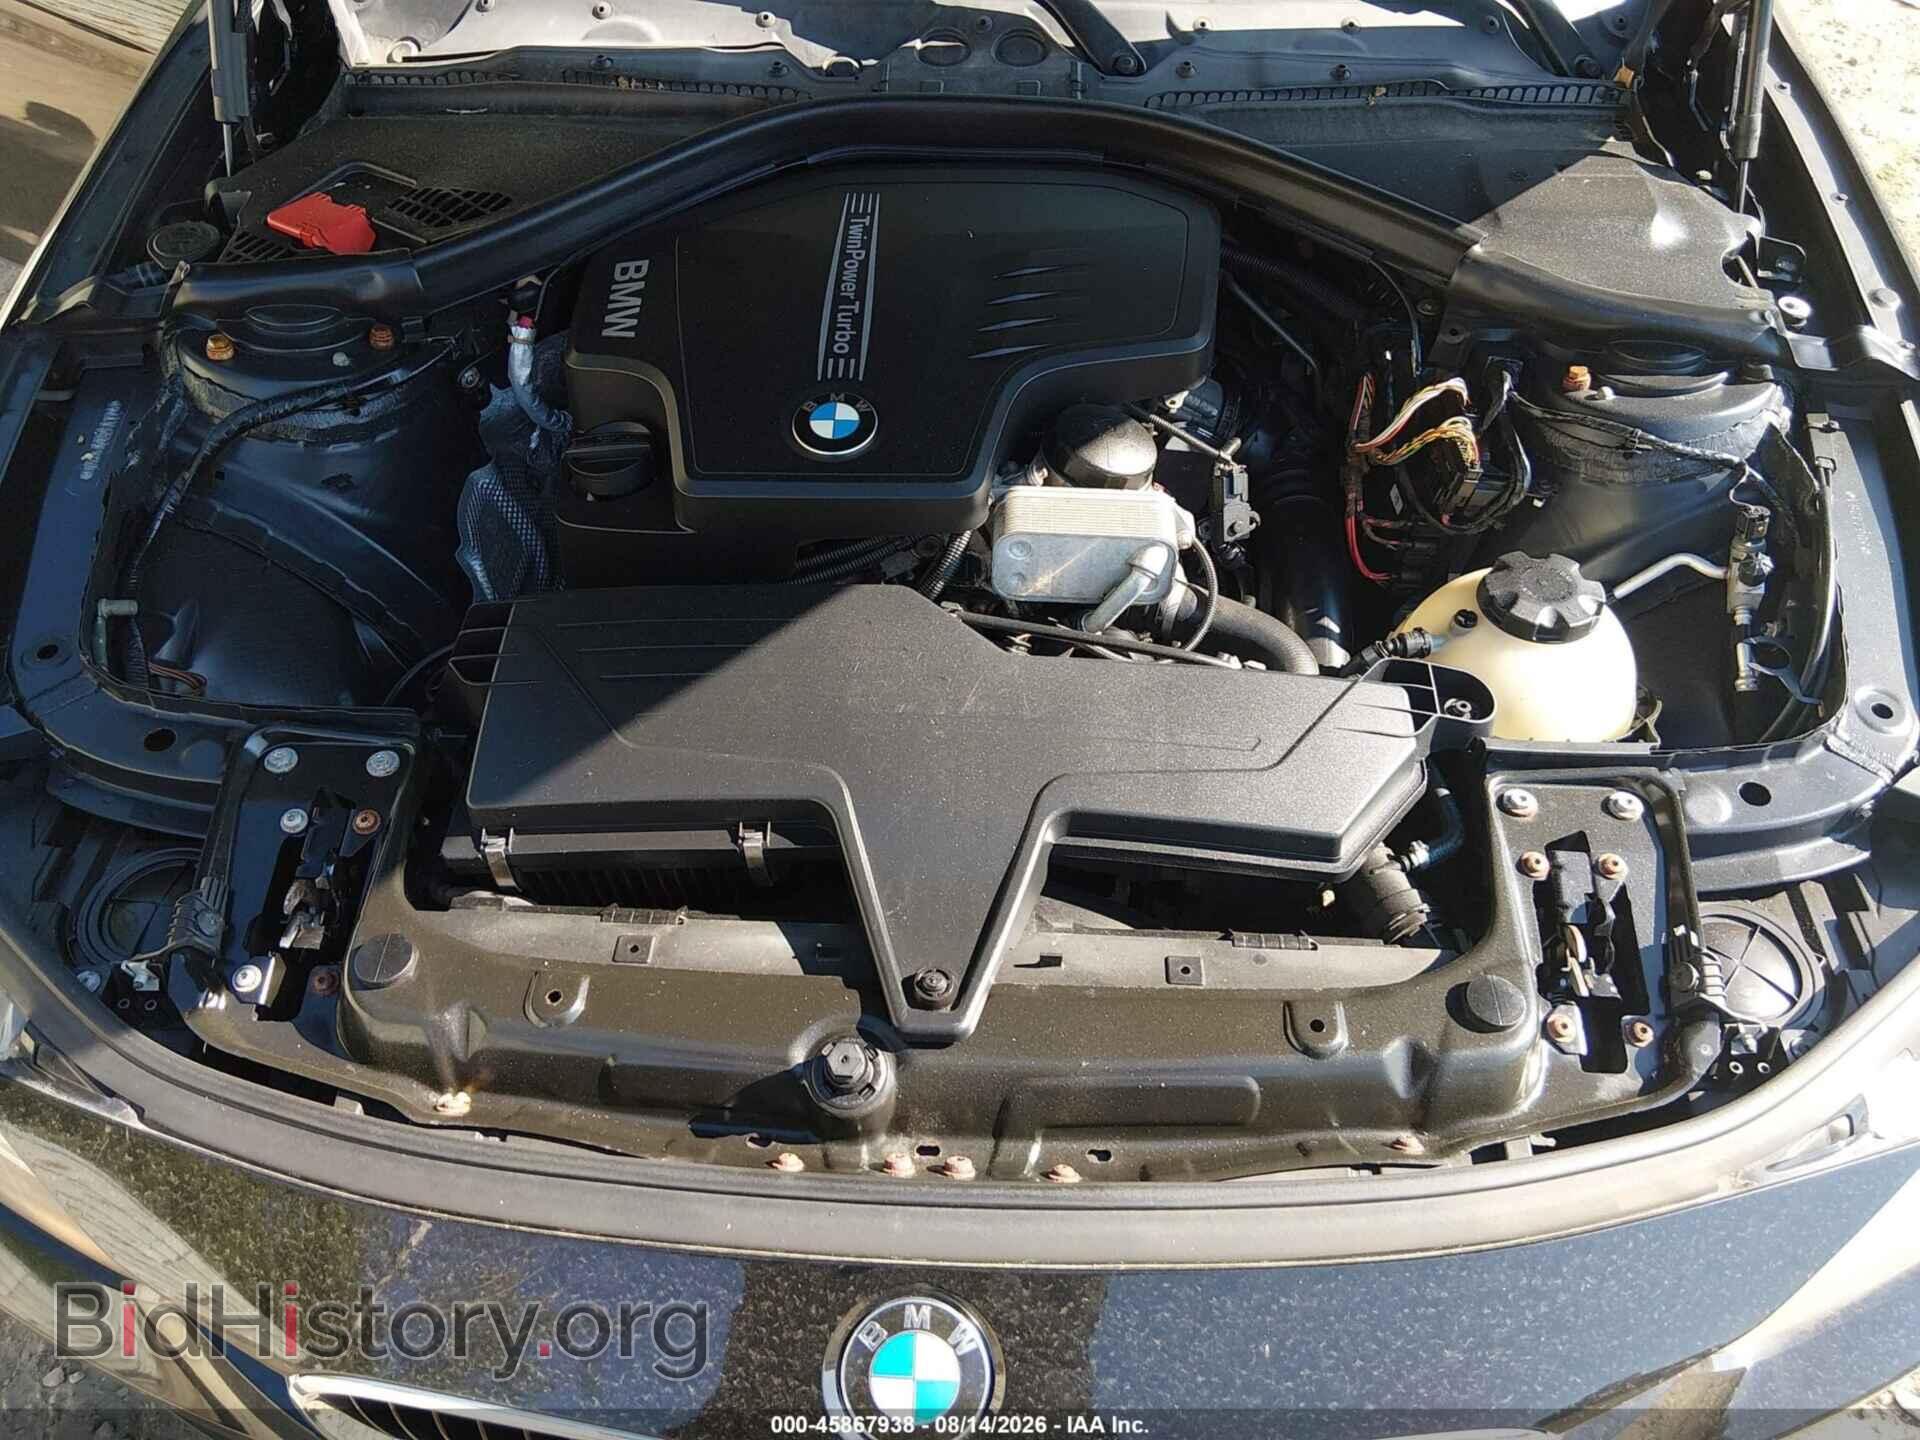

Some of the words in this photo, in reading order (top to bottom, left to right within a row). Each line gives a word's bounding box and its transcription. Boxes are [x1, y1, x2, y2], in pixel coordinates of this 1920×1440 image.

[839, 215, 870, 298] TwinPower
[601, 259, 650, 338] BMW
[833, 301, 860, 354] Turbo
[858, 1304, 979, 1356] BMW
